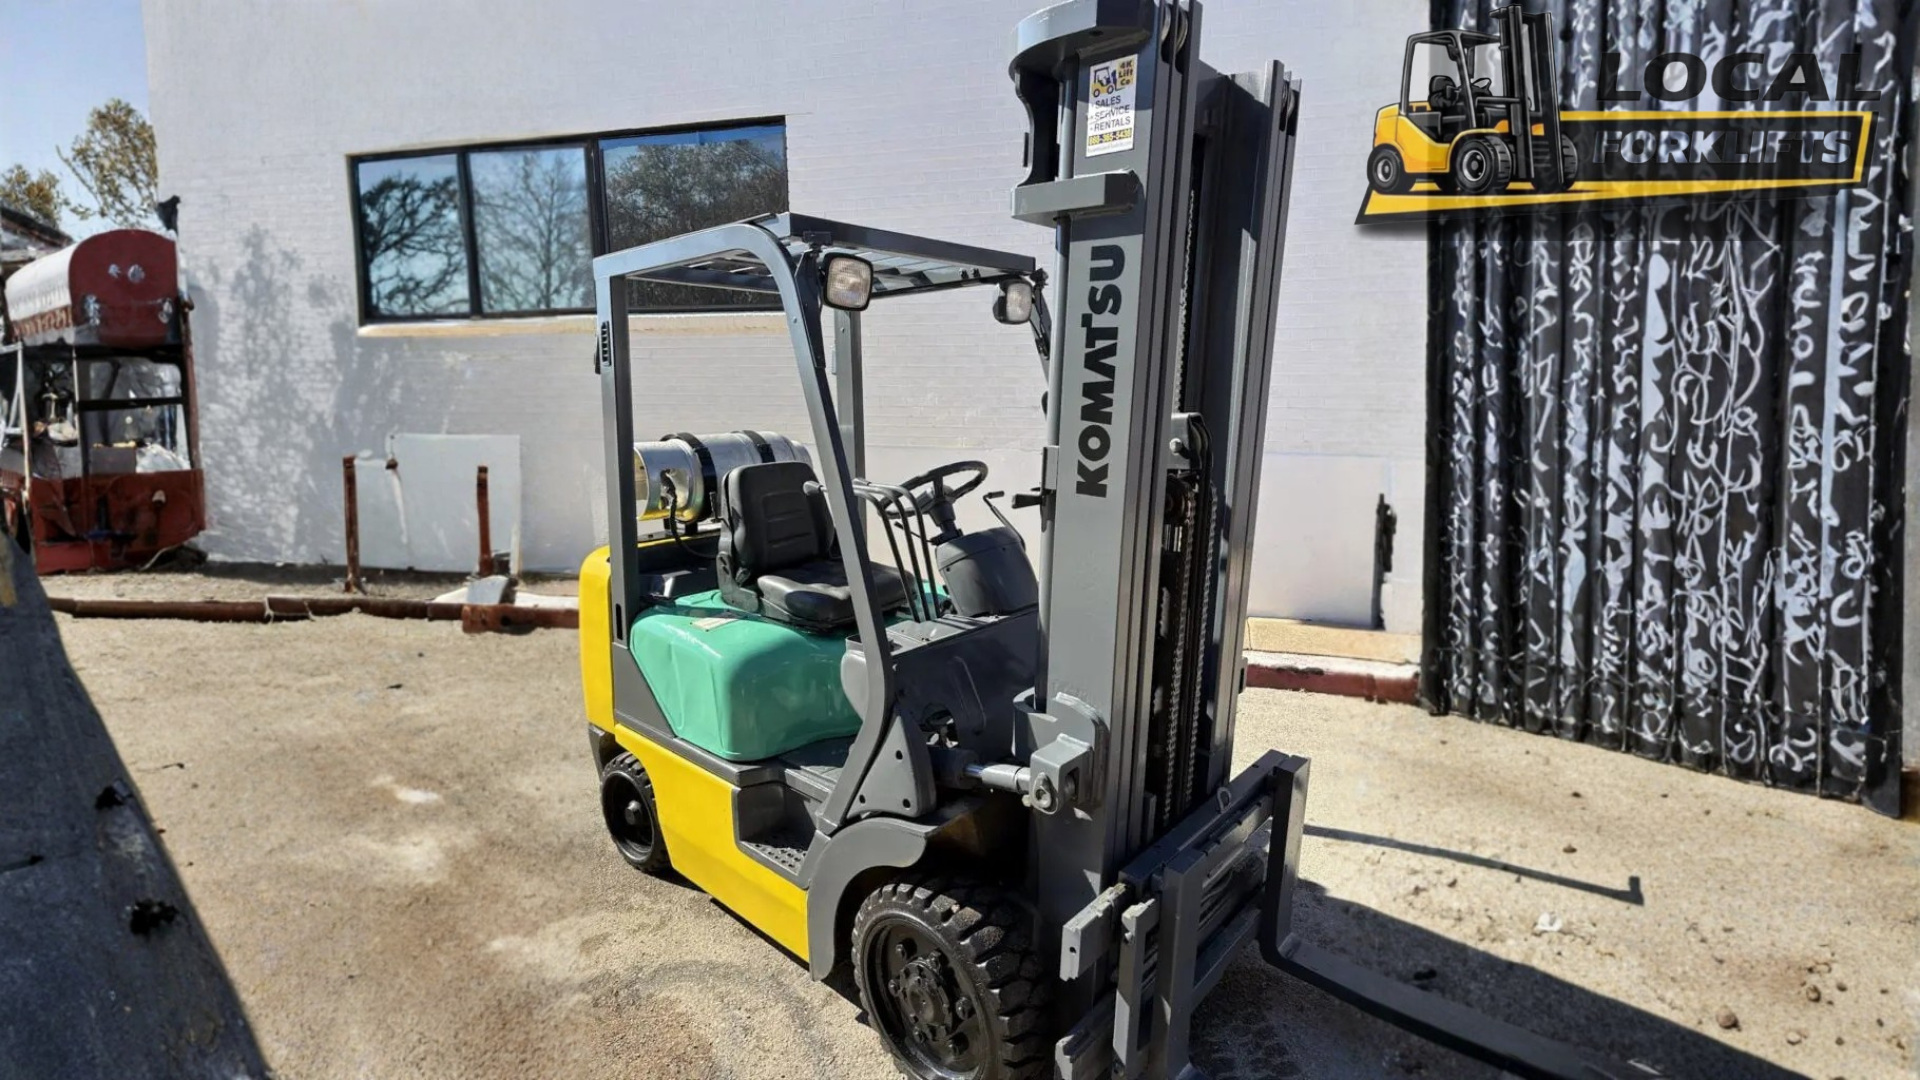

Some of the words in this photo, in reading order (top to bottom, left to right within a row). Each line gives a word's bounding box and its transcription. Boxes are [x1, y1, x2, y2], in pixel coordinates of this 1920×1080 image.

[1118, 68, 1133, 78] Lift
[1095, 95, 1121, 108] SALES
[1095, 105, 1130, 120] SERVICE
[1094, 116, 1131, 132] RENTALS
[1075, 244, 1126, 498] KOMATSU
